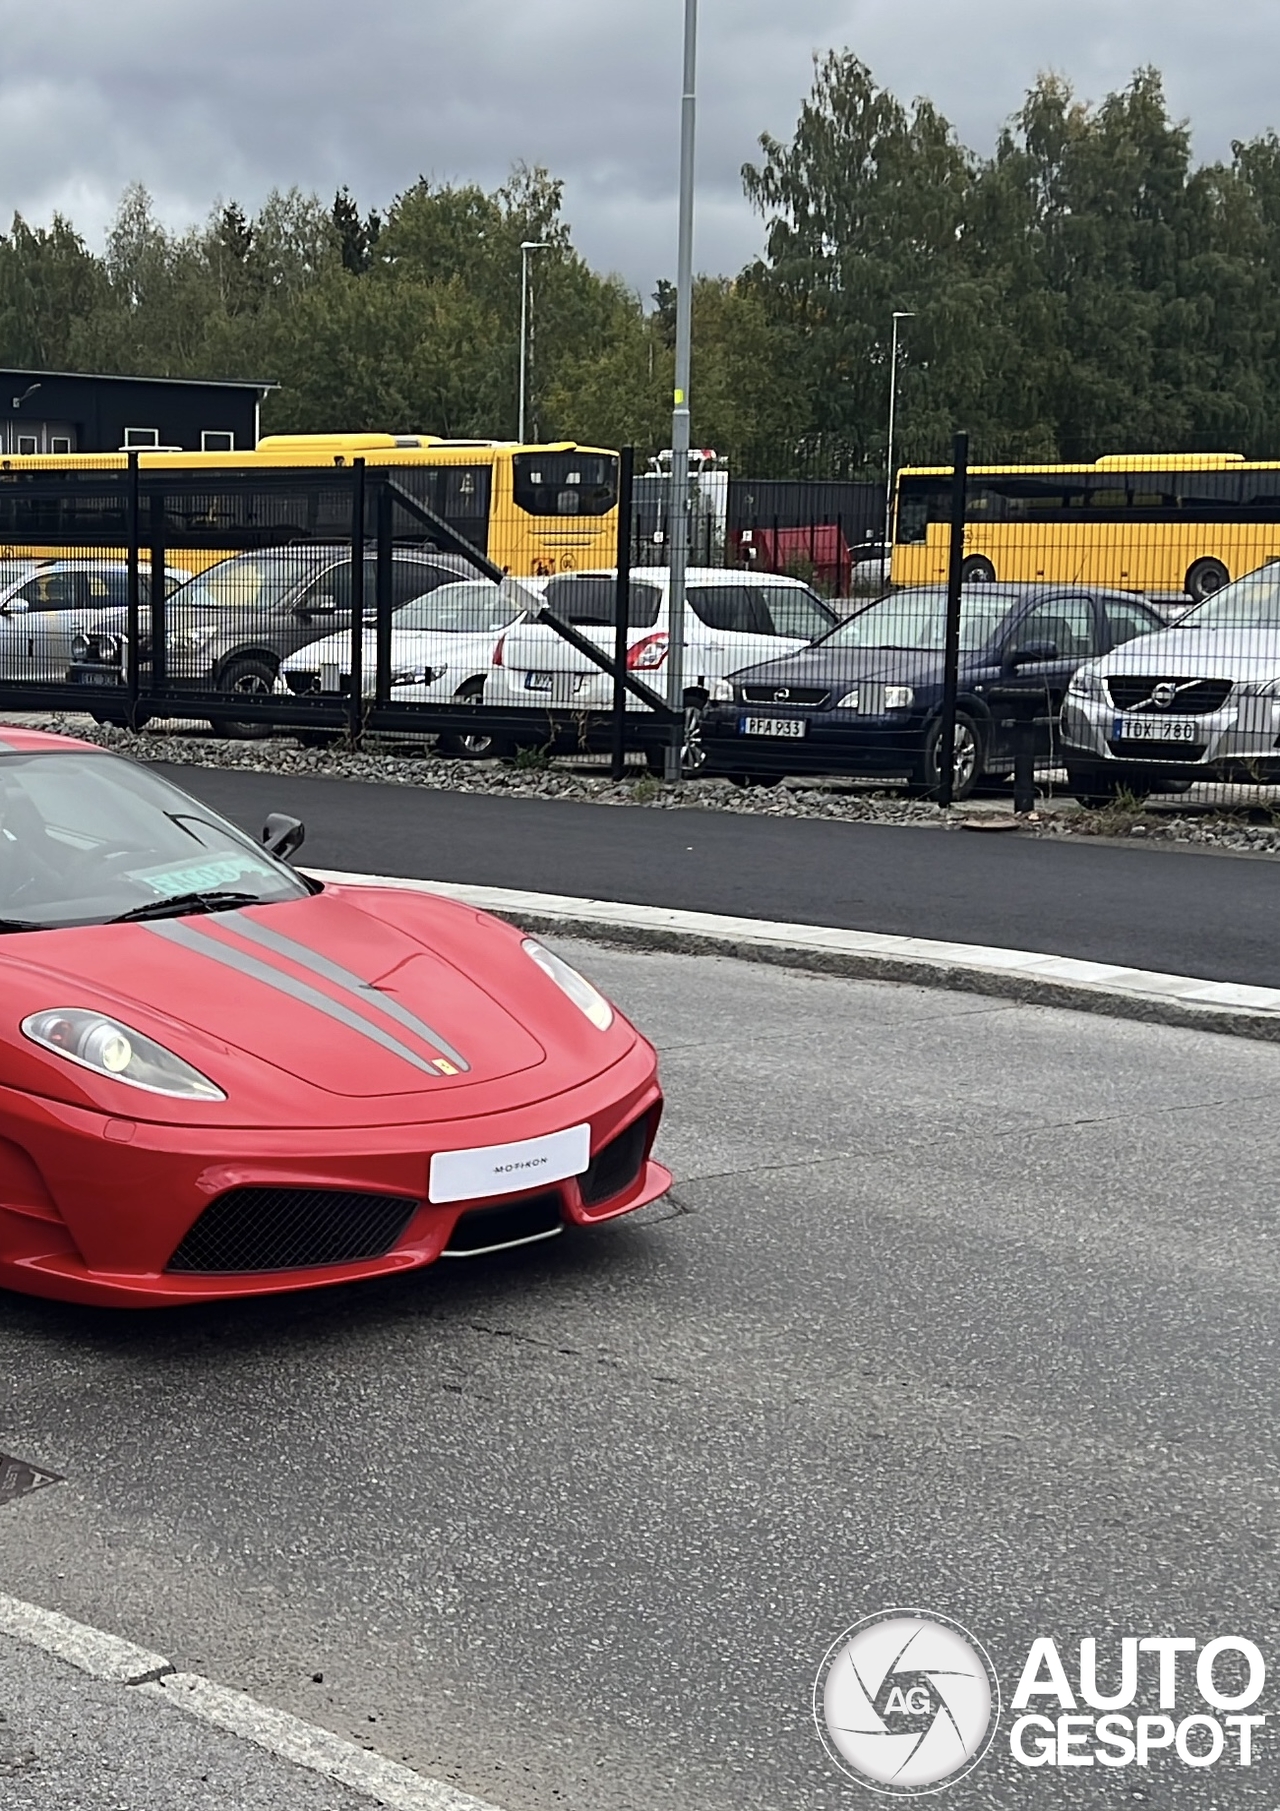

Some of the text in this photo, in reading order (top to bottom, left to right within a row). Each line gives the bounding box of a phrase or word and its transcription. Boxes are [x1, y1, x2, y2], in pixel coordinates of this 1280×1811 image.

[749, 718, 800, 736] RFA 933
[1164, 722, 1192, 739] 780
